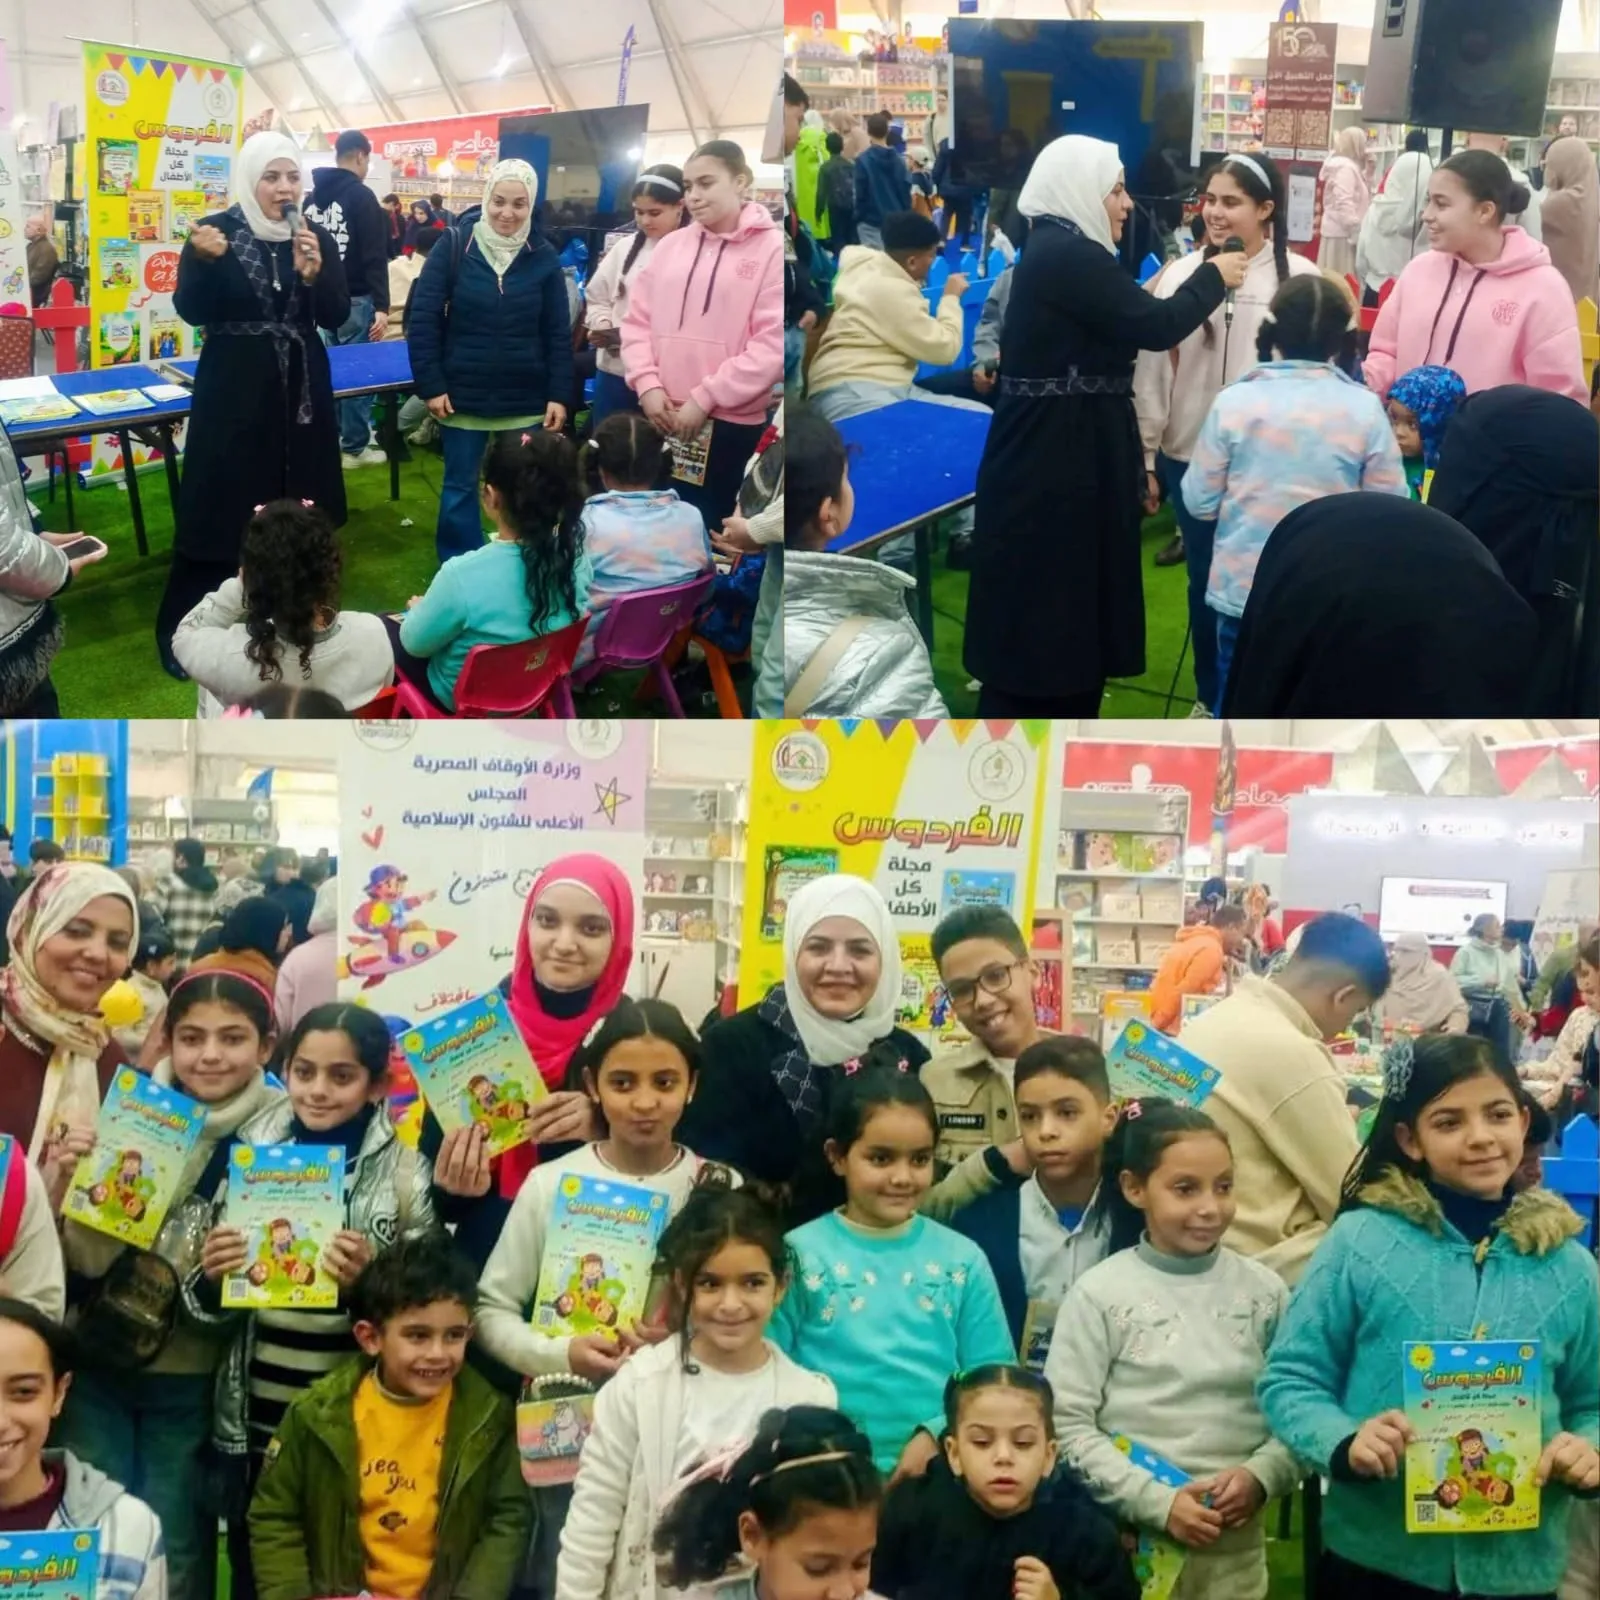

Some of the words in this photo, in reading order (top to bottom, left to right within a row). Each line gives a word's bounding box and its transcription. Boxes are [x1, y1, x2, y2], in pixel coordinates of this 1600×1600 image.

[134, 119, 233, 146] الفردوس
[165, 146, 189, 159] مجلة
[170, 160, 184, 170] كل
[413, 754, 478, 774] المصرية
[482, 757, 538, 777] الأوقاف
[543, 760, 581, 780] وزارة
[467, 786, 528, 802] المجلس
[402, 809, 475, 829] الإسلامية
[535, 815, 584, 830] الأعلى
[833, 804, 1025, 854] الفردوس
[888, 856, 932, 873] مجلة
[894, 878, 922, 897] كل
[888, 900, 937, 917] الأطفا
[1421, 1362, 1523, 1391] الفردوس
